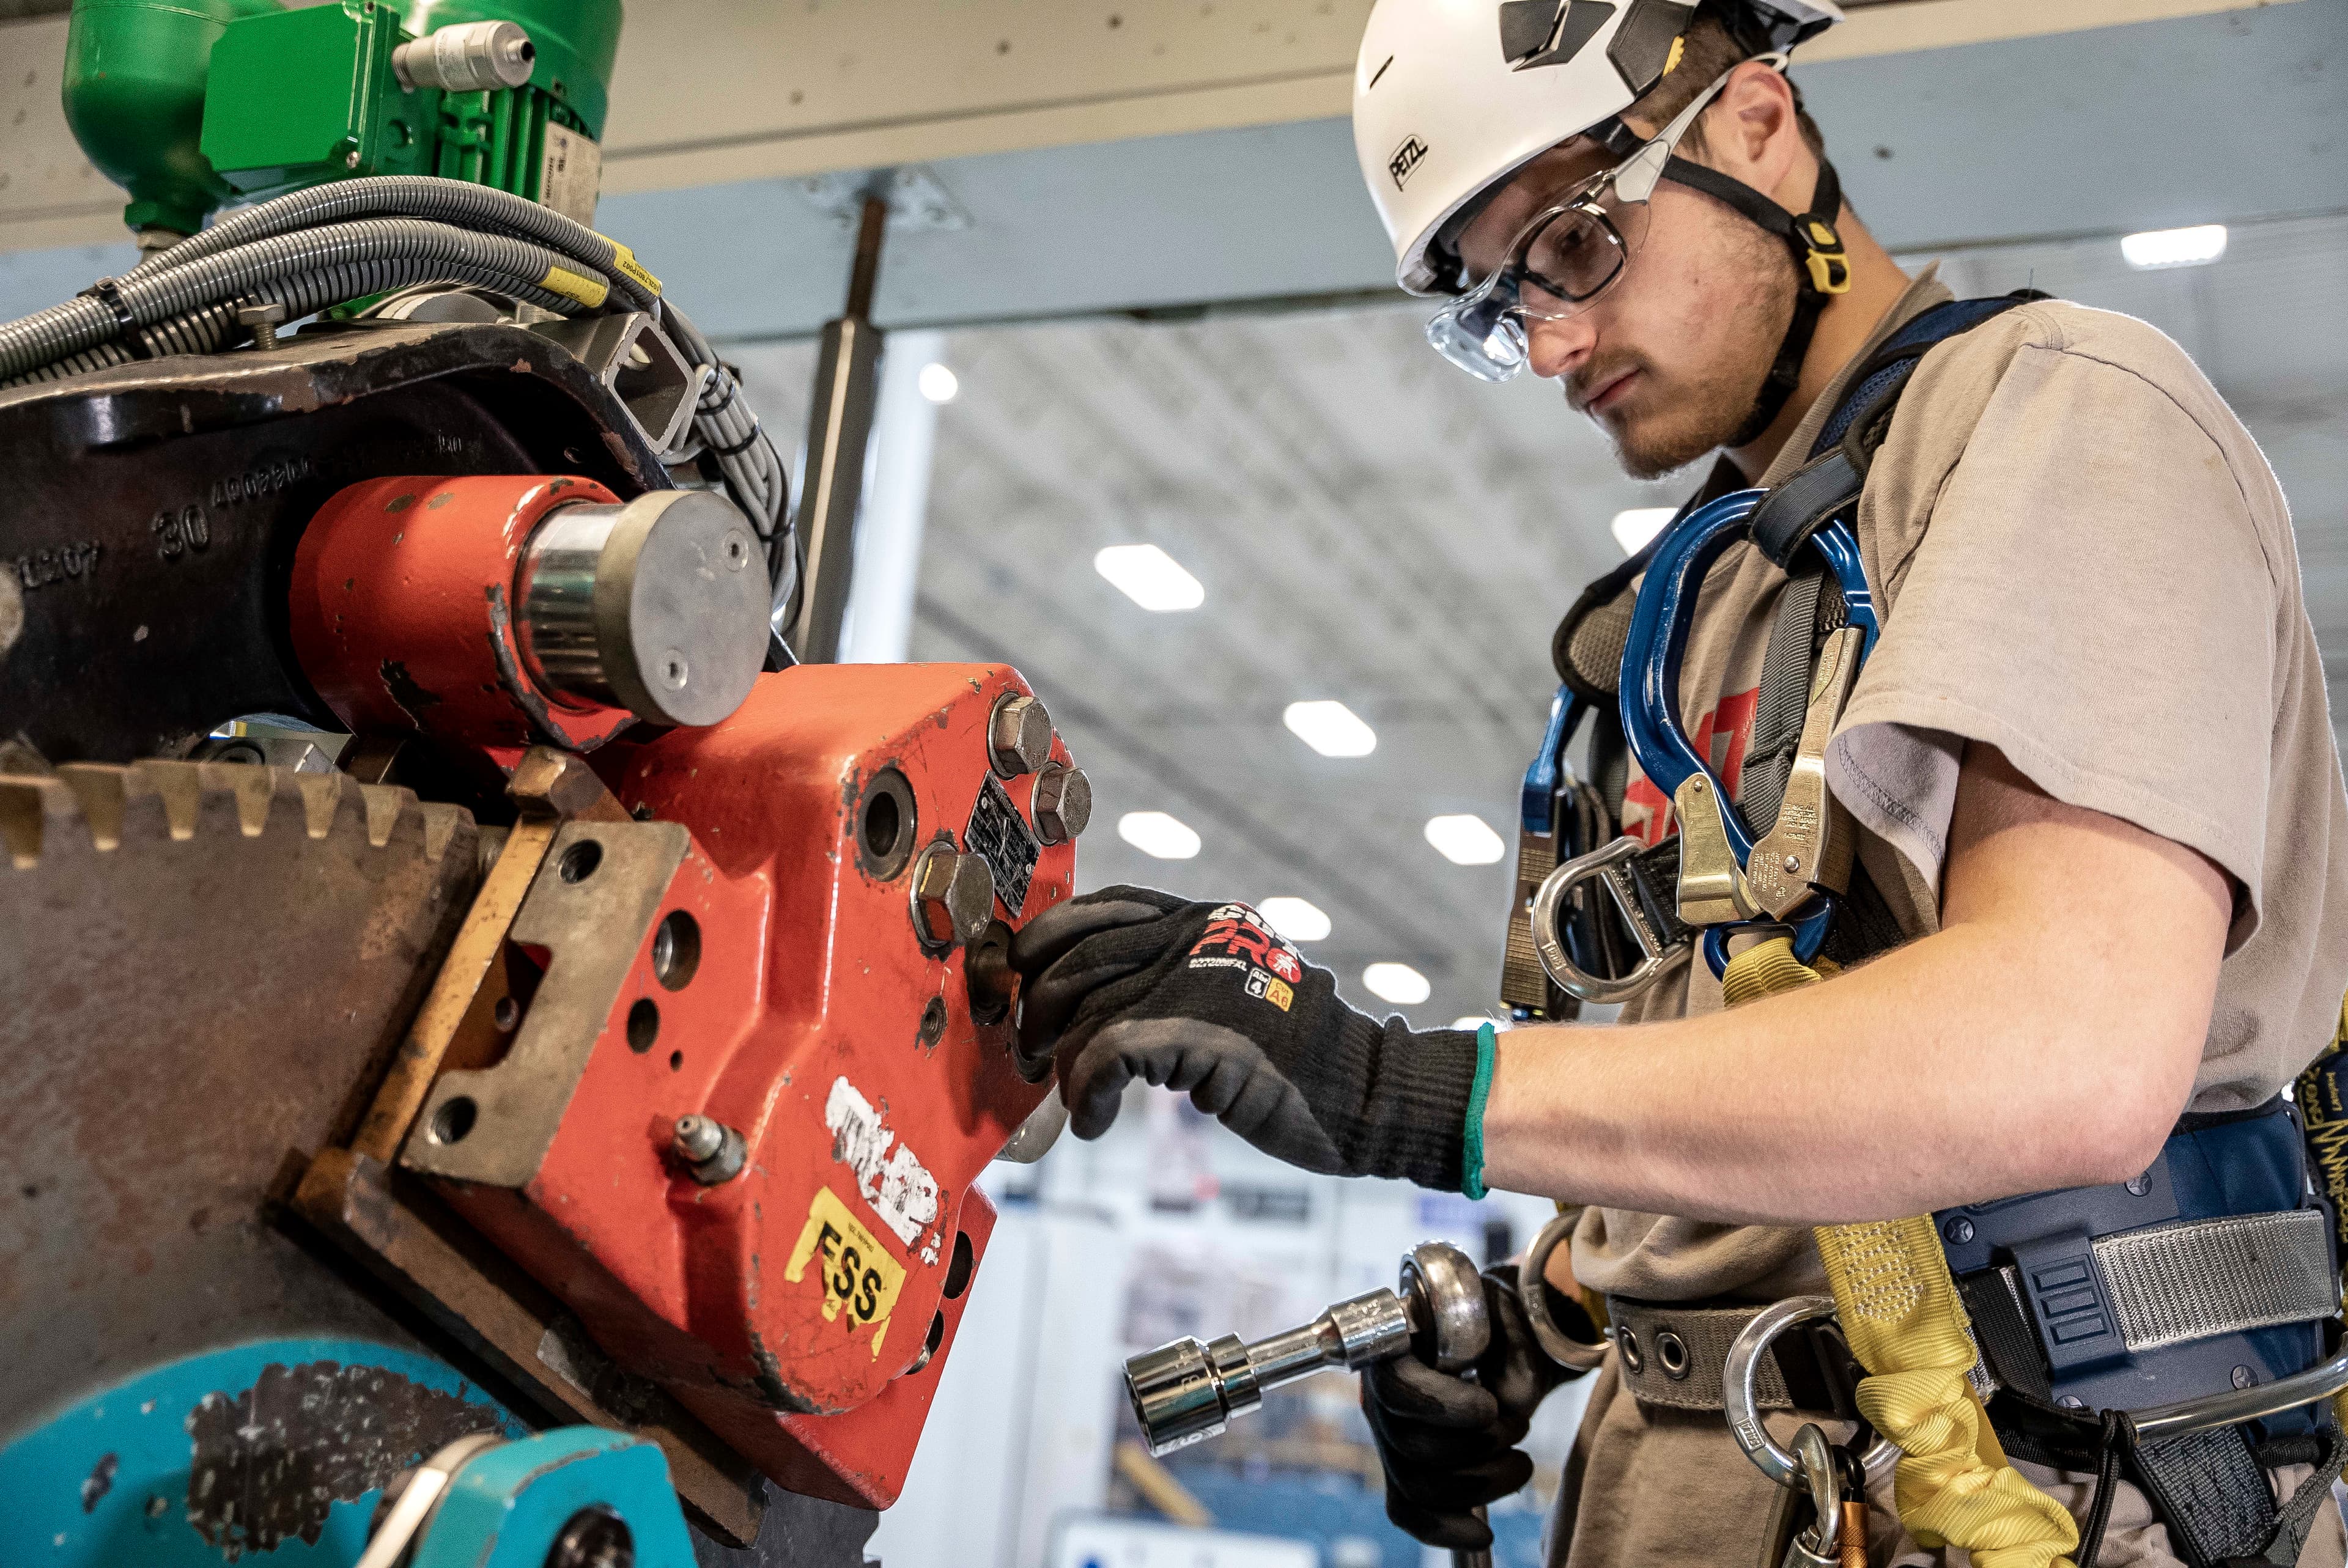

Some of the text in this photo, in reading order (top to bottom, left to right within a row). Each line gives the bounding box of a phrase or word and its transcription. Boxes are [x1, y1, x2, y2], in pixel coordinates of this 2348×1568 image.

[1389, 138, 1428, 192] PETZL
[153, 506, 209, 561] 30
[995, 787, 1034, 846] SVENDBORG BRAKES
[1189, 919, 1301, 984] PRO
[1250, 981, 1262, 995] 4
[1269, 990, 1288, 1008] A6
[814, 1221, 880, 1320] FSS
